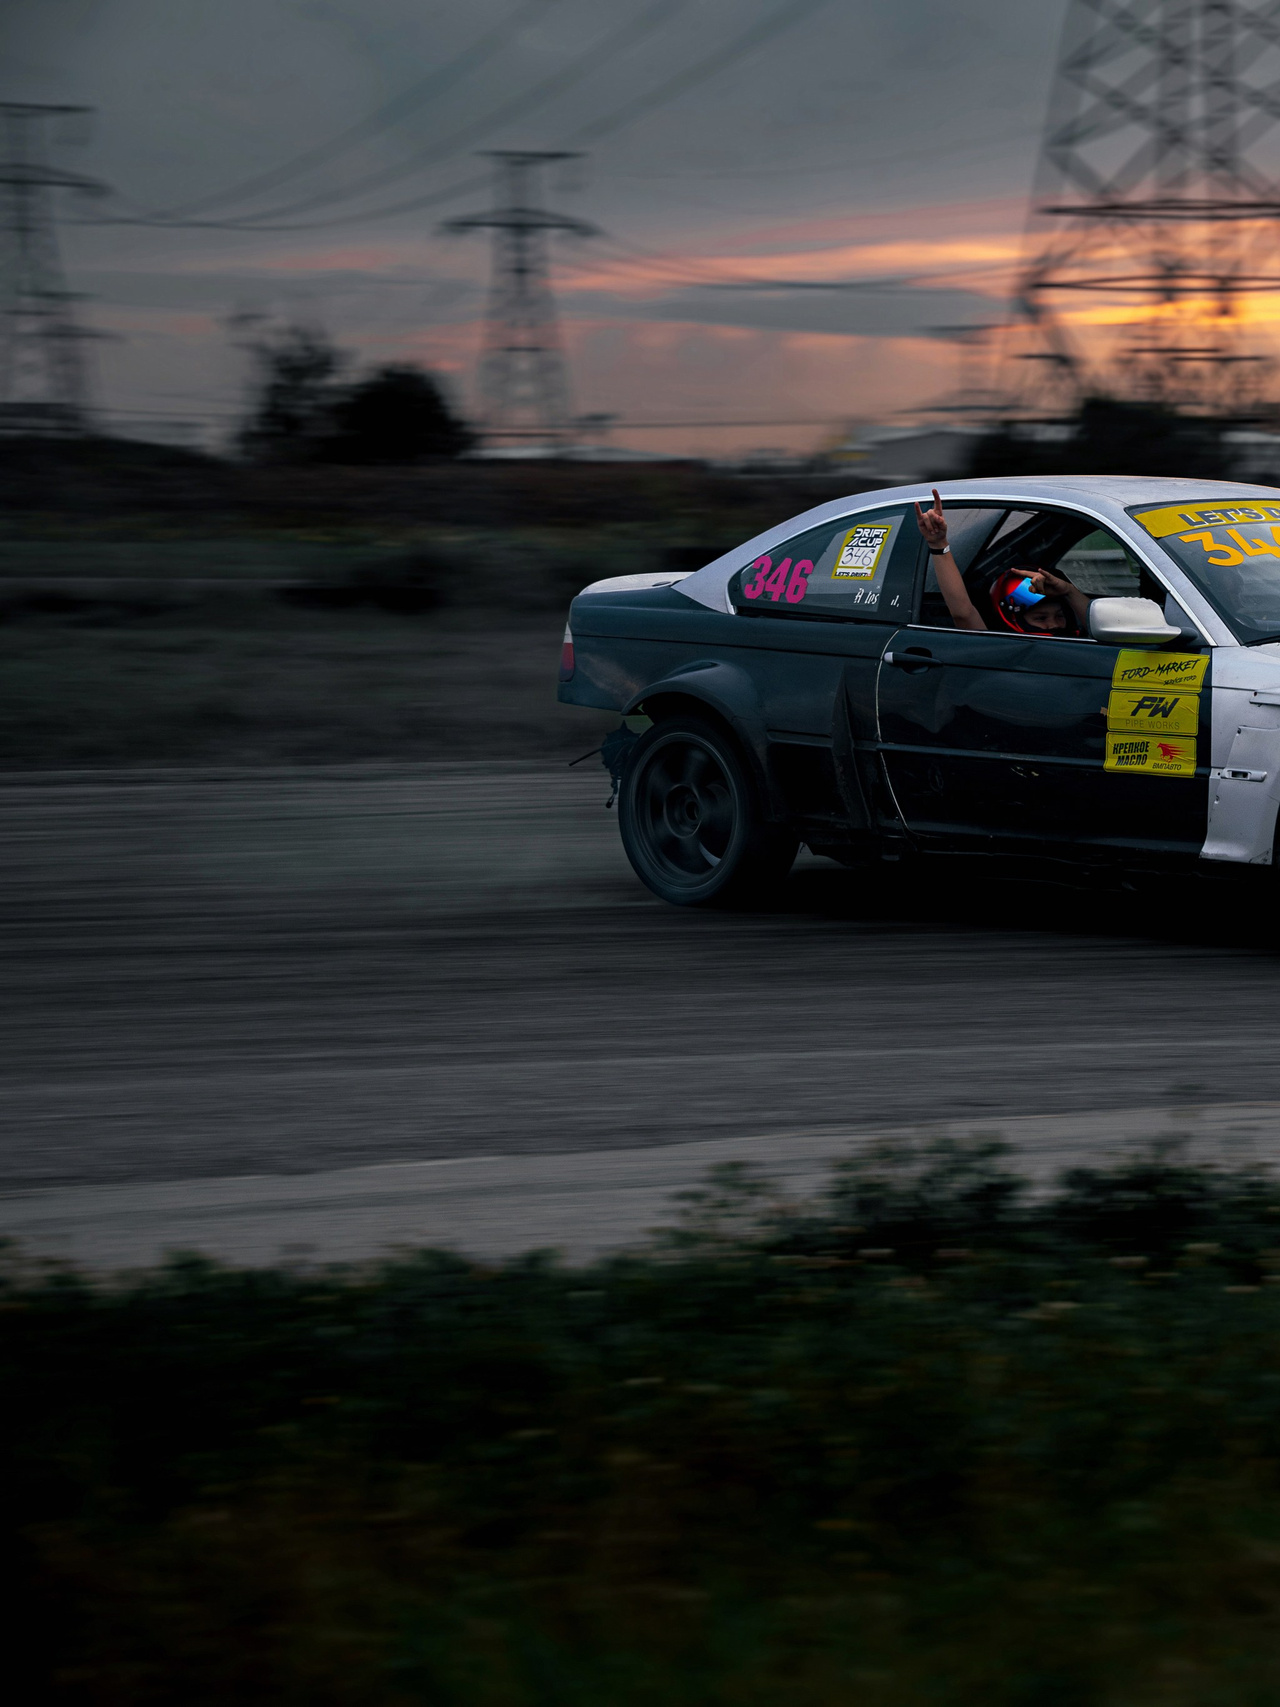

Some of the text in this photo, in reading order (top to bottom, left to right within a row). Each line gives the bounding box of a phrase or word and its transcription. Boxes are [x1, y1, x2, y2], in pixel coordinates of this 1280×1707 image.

[1178, 507, 1264, 526] LET'S
[853, 528, 888, 538] DRIFT
[842, 547, 876, 566] 346
[744, 555, 815, 604] 346
[1121, 658, 1201, 681] FORD-MARKET
[1125, 719, 1180, 730] PIPE WORKS
[1113, 741, 1150, 754] КРЕПКОЕ
[1116, 754, 1148, 765] МАСЛО
[1152, 762, 1182, 771] ВМПАВТО
